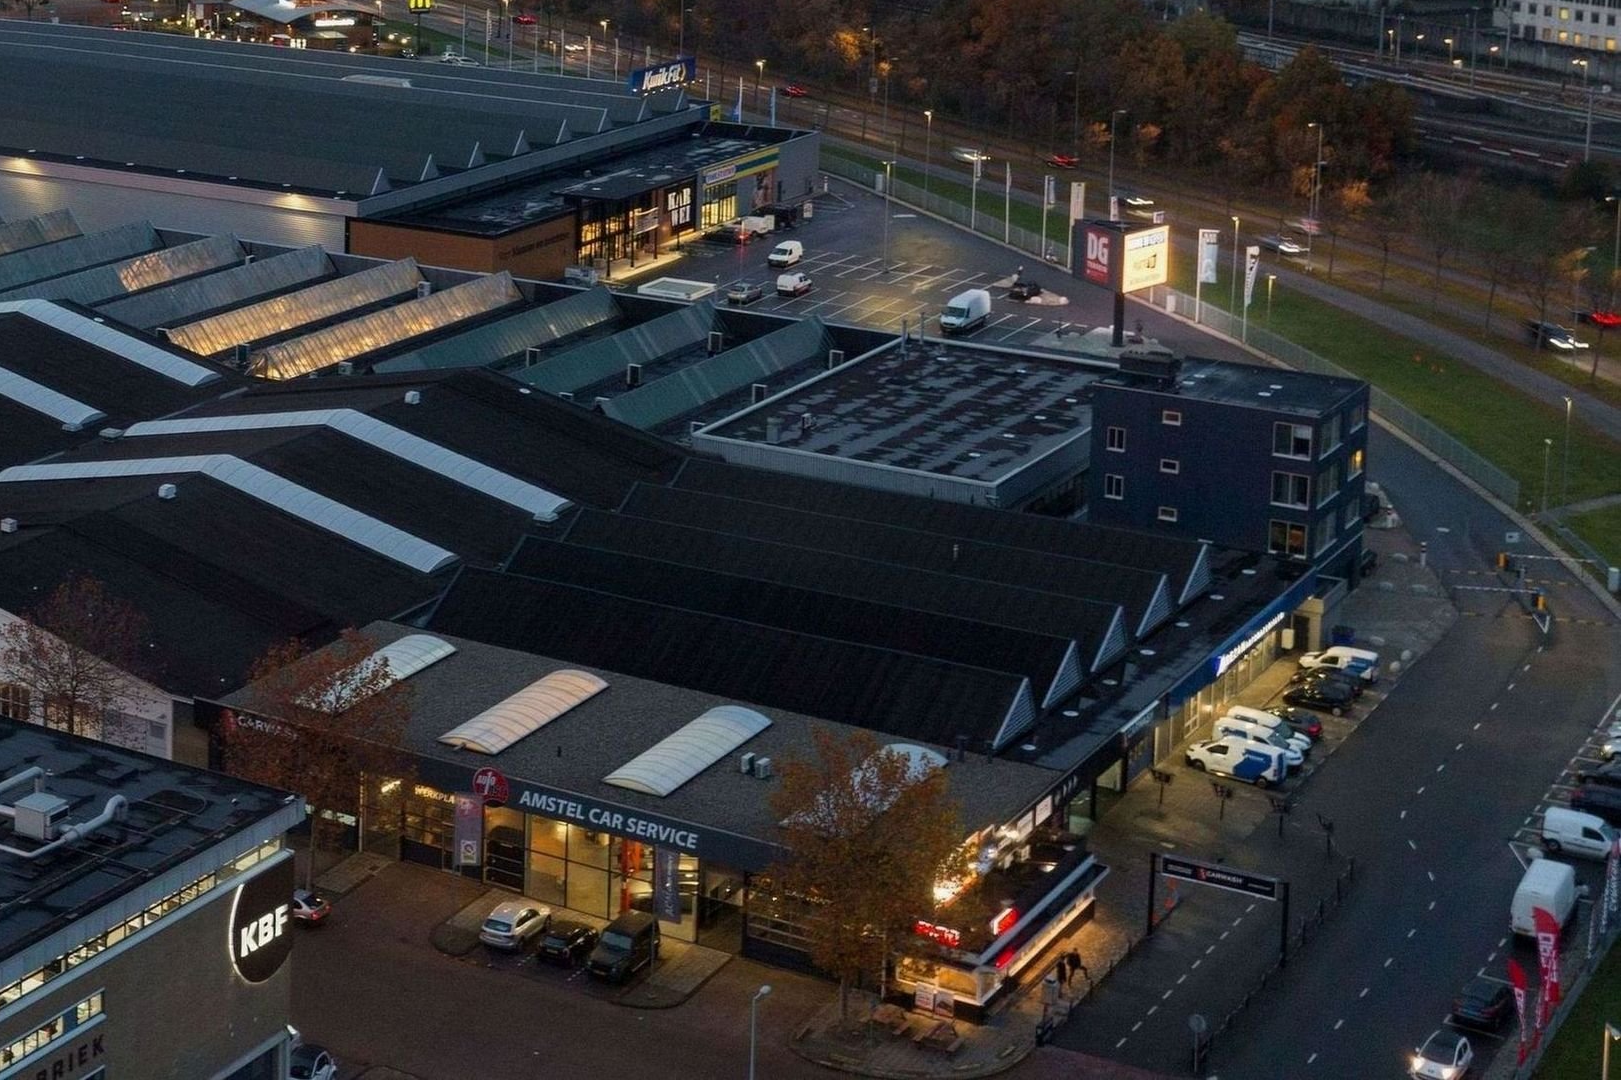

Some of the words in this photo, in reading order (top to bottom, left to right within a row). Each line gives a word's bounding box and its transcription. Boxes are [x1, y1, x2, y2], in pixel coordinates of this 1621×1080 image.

[1087, 232, 1109, 265] DG
[519, 791, 584, 819] AMSTEL
[588, 808, 622, 830] CAR
[626, 818, 699, 849] SERVICE
[241, 904, 288, 957] KBF
